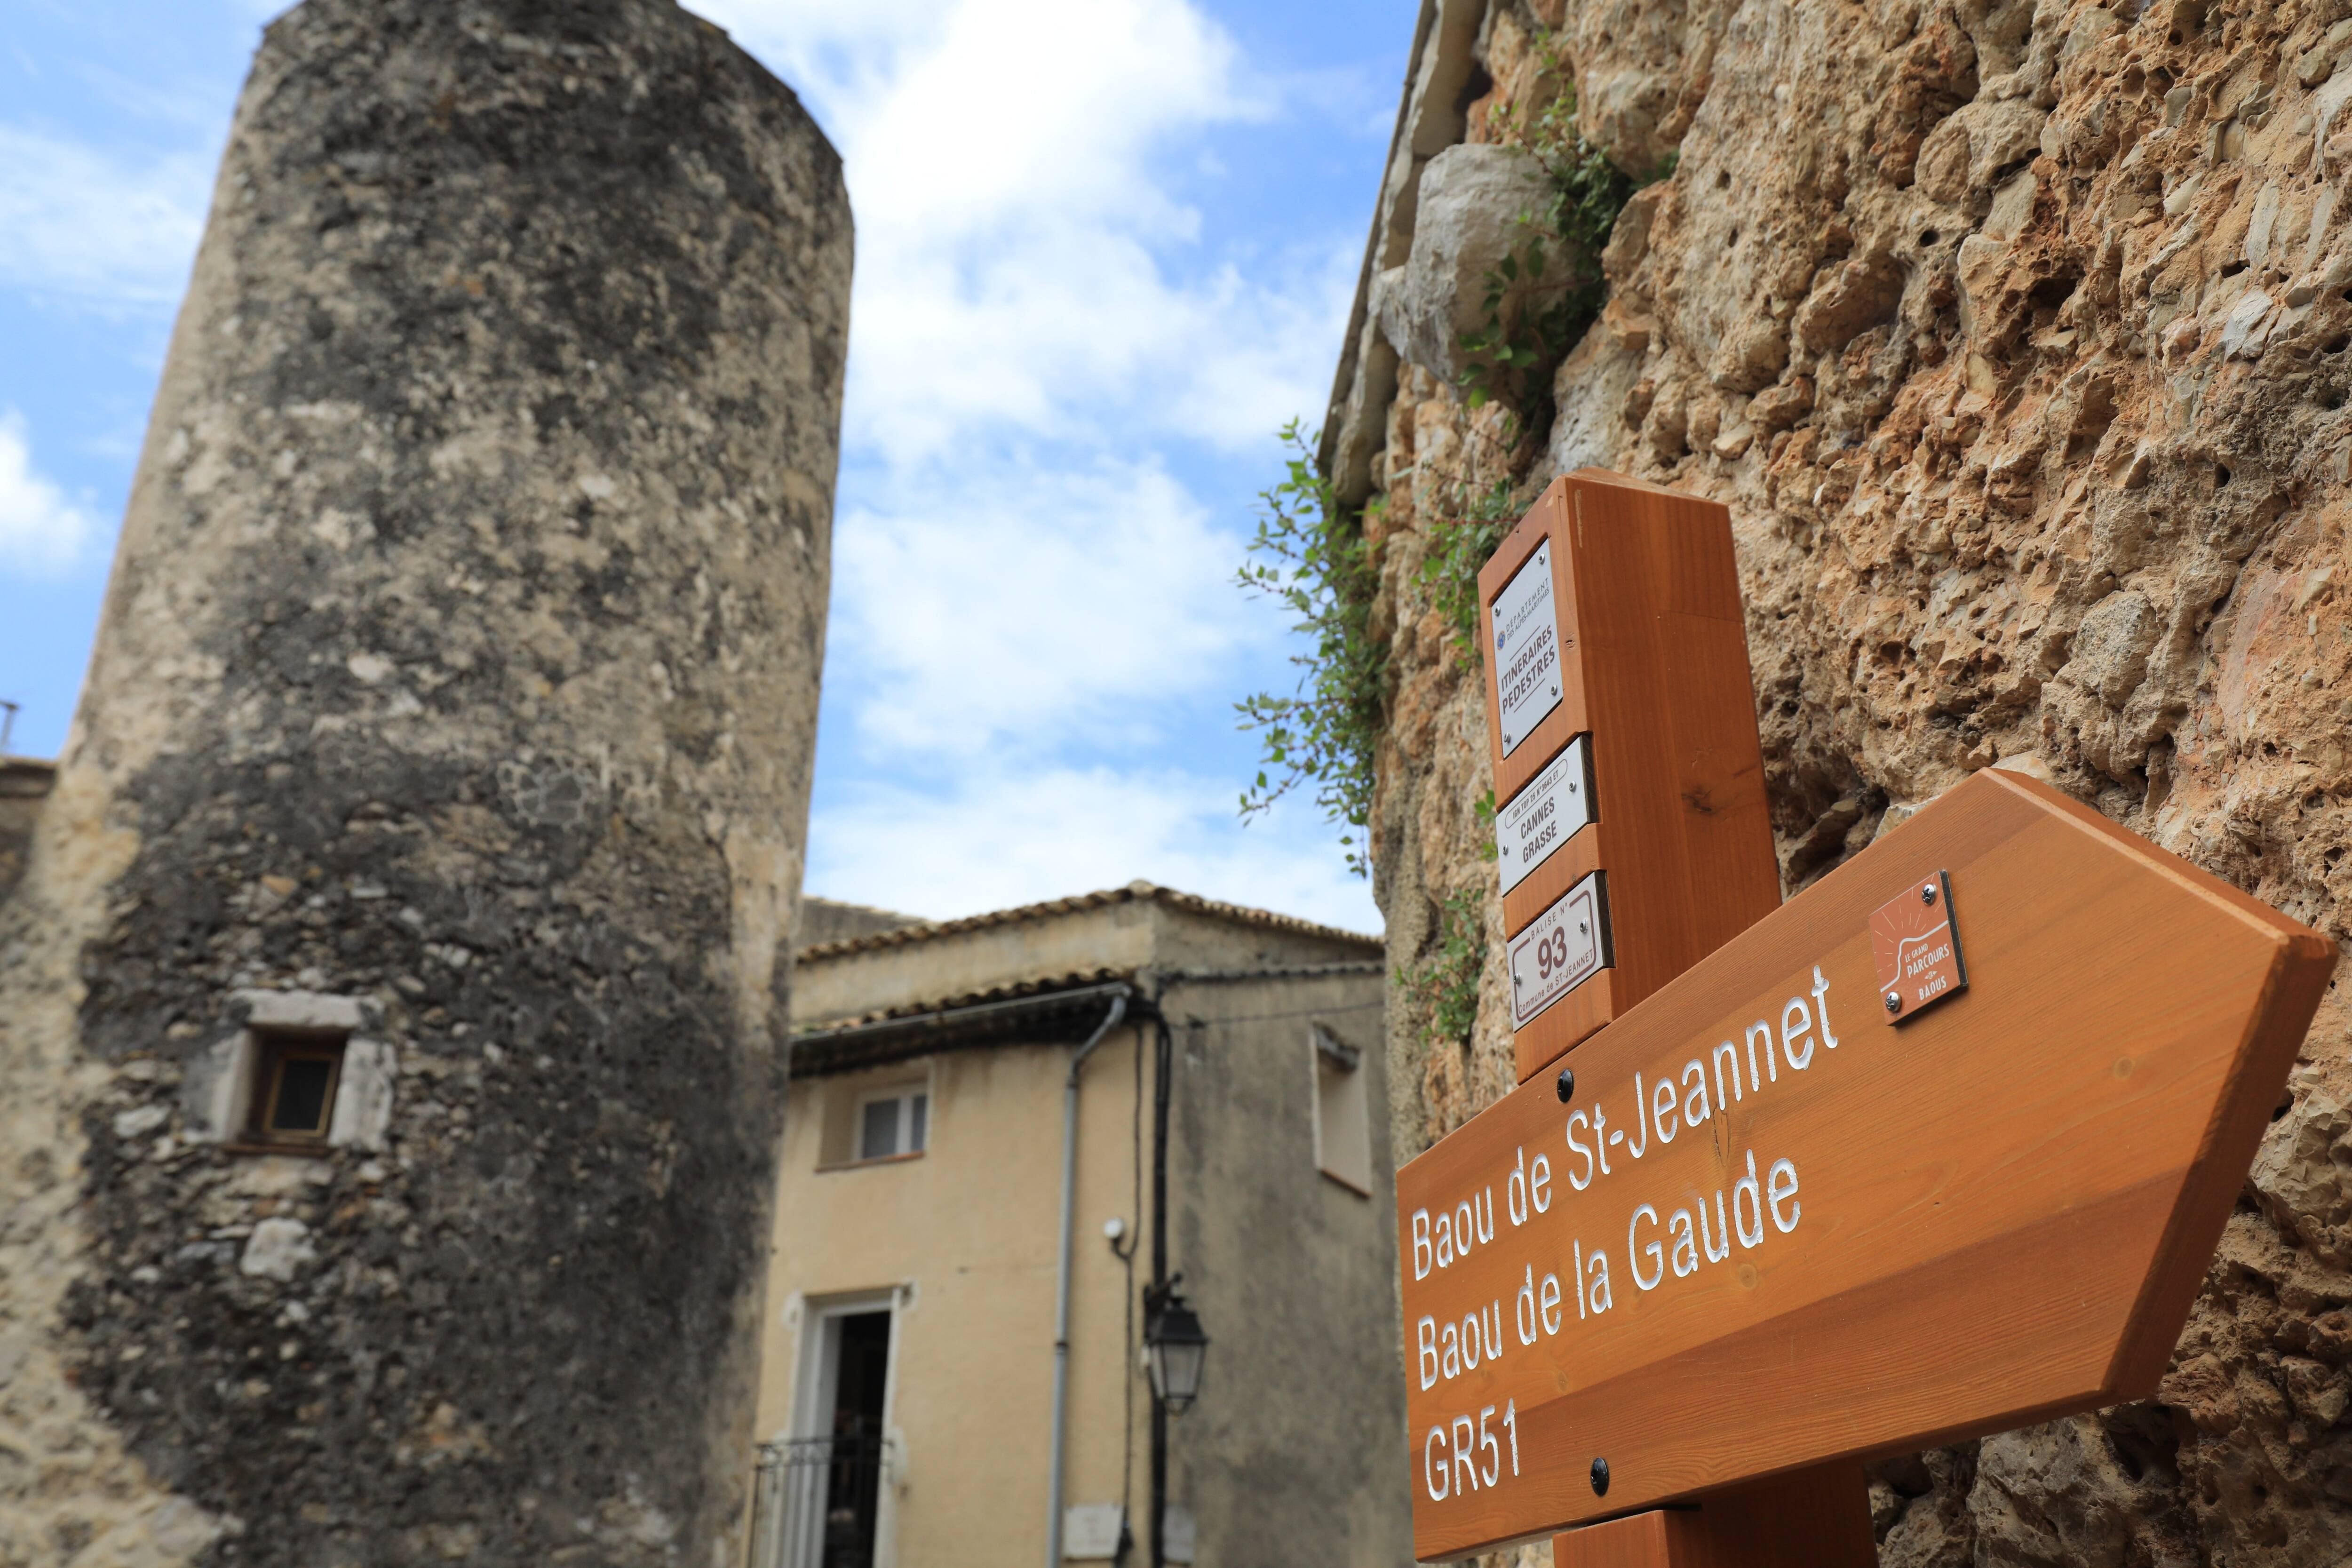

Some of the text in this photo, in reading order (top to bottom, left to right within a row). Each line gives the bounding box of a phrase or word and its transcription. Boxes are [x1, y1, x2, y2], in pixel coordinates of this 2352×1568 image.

[1506, 577, 1549, 632] DÉPARTEMENT
[1515, 587, 1549, 632] ALPES-MARITIMES
[1502, 624, 1552, 692] ITINERAIRES
[1503, 645, 1555, 715] PEDESTRES
[1521, 798, 1529, 810] TOP
[1530, 792, 1536, 802] 25
[1553, 770, 1558, 780] ET
[1520, 796, 1555, 840] CANNES
[1523, 820, 1557, 863] GRASSE
[1531, 902, 1567, 939] BALISE N°
[1538, 926, 1567, 979] 93
[1905, 943, 1928, 963] LE GRAND
[1907, 943, 1950, 979] PARCOURS
[1518, 949, 1593, 1014] Commune de ST-JEANNET
[1919, 975, 1947, 1001] BAOUS
[1413, 965, 1838, 1281] Baou de St-Jeannet
[1418, 1149, 1801, 1392] Baou de la Gaude
[1425, 1398, 1520, 1501] GR51
